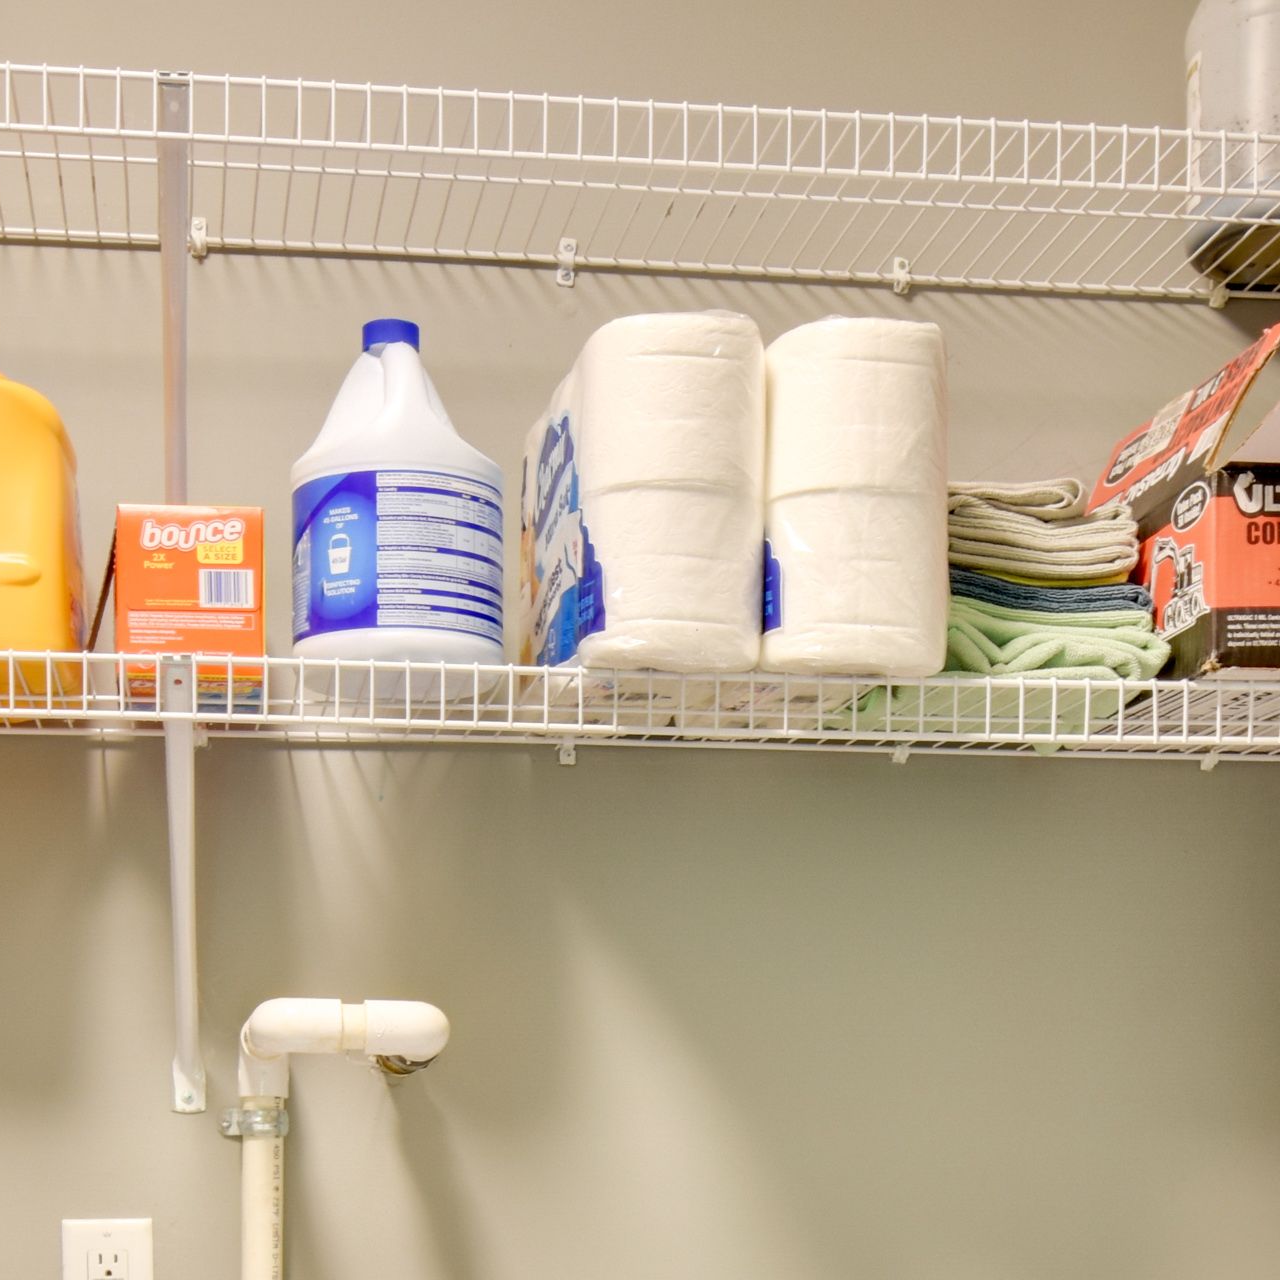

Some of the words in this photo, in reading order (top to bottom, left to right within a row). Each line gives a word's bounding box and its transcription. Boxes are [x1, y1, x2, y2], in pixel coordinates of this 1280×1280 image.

[142, 519, 243, 549] bounce
[204, 545, 237, 553] SELECT
[152, 554, 165, 562] 2X
